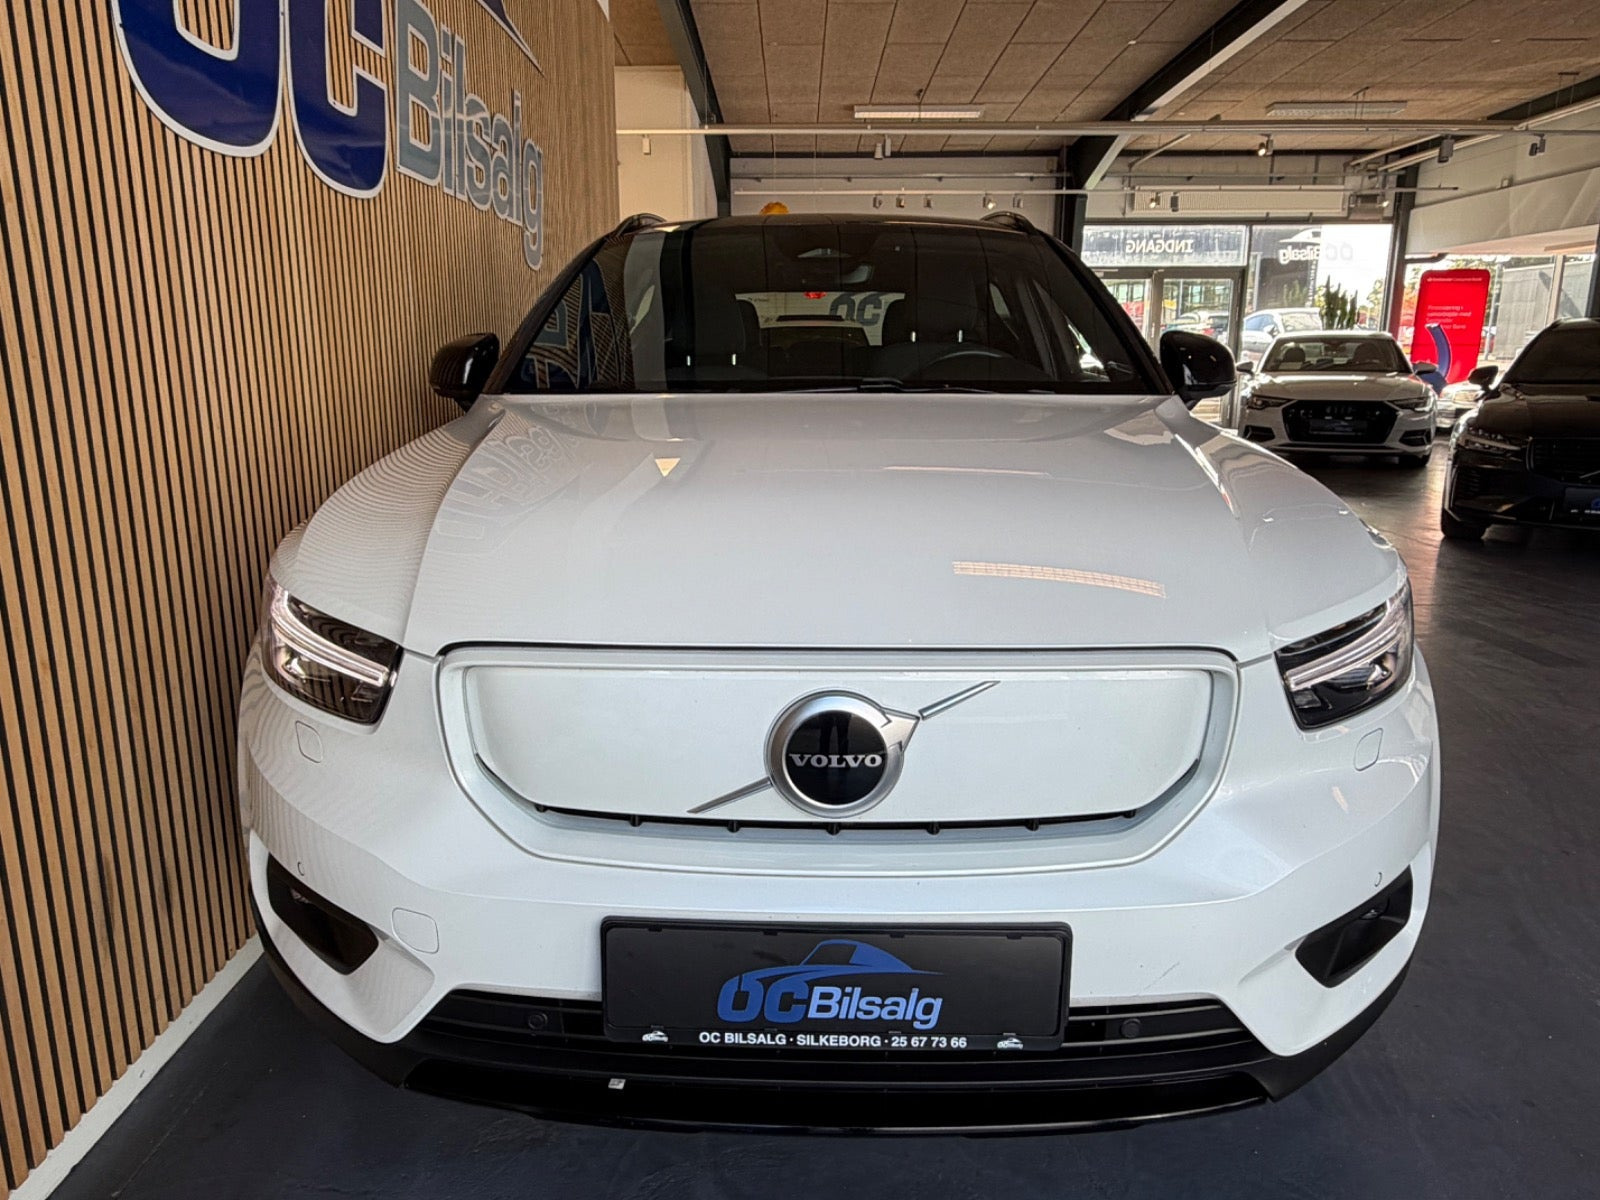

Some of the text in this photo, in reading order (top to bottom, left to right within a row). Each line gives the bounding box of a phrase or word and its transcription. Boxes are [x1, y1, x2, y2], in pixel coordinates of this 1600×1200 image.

[396, 0, 544, 271] Bilsalg
[789, 753, 883, 768] VOLVO
[807, 986, 943, 1030] Bilsalg
[699, 1031, 967, 1048] OC BILSALG SILKEBORG 25 67 73 66
